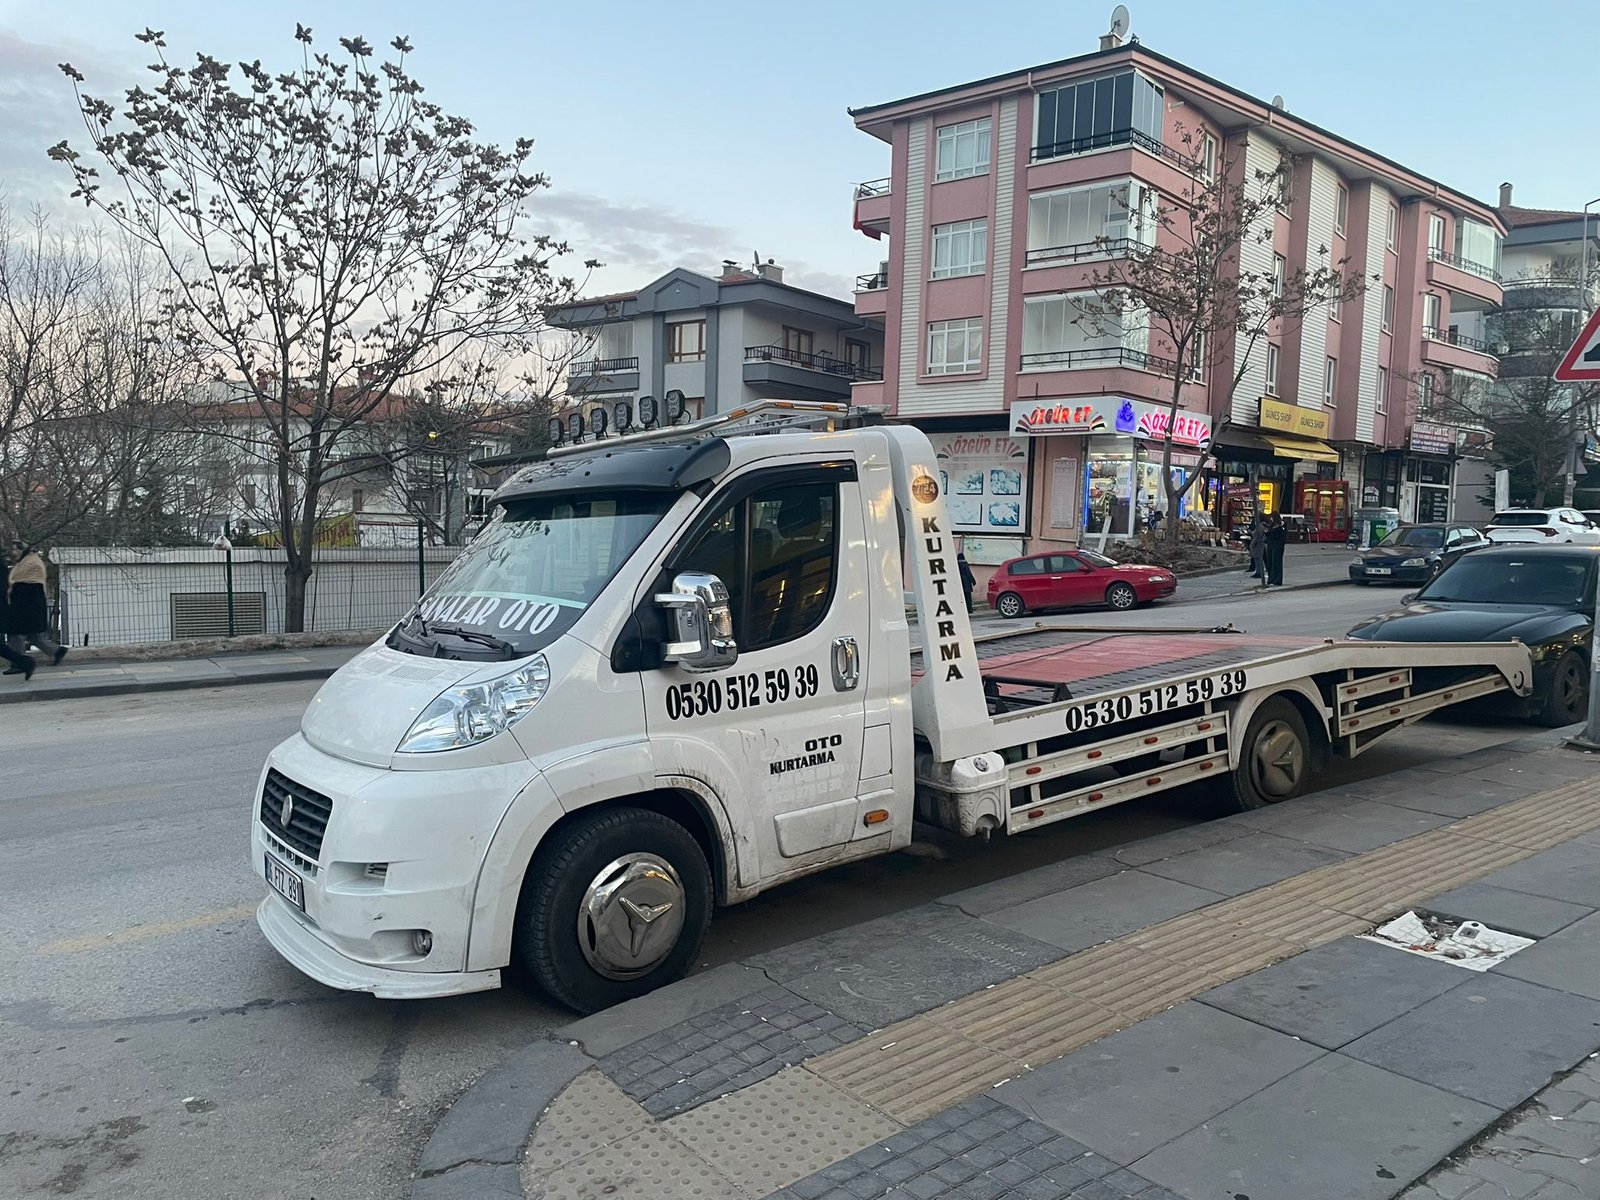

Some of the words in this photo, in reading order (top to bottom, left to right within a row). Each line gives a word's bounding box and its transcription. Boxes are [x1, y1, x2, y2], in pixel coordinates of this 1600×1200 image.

[1029, 404, 1071, 425] ÖZGÜR
[1073, 405, 1092, 423] ET
[1280, 412, 1292, 423] SHOP
[1313, 419, 1325, 430] SHOP
[1187, 418, 1199, 437] ET
[953, 434, 991, 455] ÖZGÜR
[995, 437, 1010, 454] ET
[922, 516, 964, 682] KURTARMA
[498, 599, 560, 635] OTO
[665, 685, 722, 720] 0530
[726, 673, 761, 710] 512
[764, 668, 790, 704] 59
[794, 663, 819, 698] 39
[1065, 695, 1132, 732] 0530
[1139, 684, 1179, 715] 512
[1186, 677, 1213, 704] 59
[1220, 669, 1247, 695] 39
[804, 734, 842, 752] OTO
[769, 750, 836, 775] KURTARMA
[274, 866, 285, 893] FTZ
